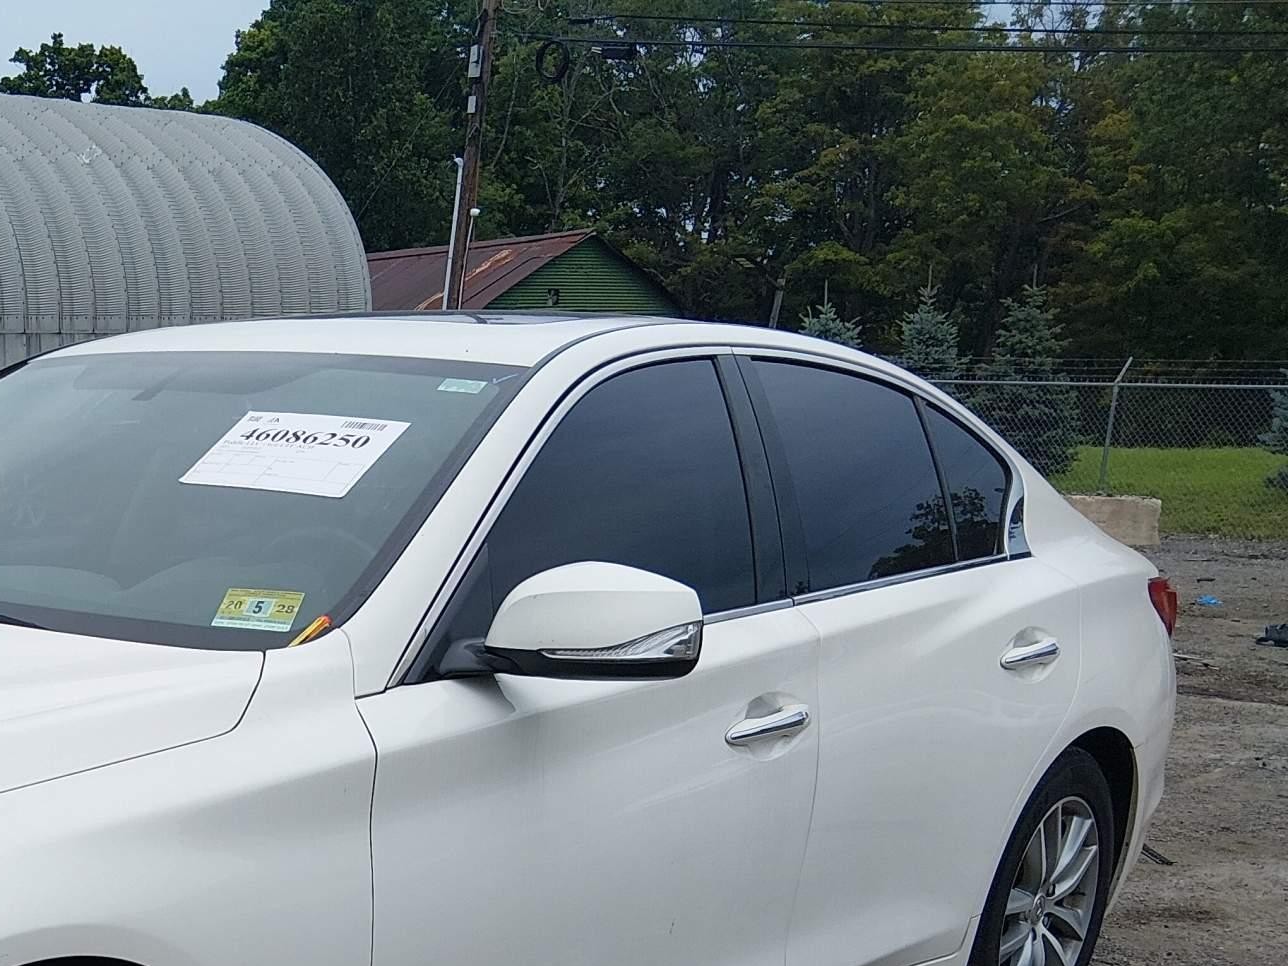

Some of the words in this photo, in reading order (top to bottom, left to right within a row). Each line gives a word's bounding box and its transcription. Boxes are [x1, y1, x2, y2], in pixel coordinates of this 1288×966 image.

[240, 427, 371, 449] 46086250
[225, 600, 243, 610] 20
[252, 600, 265, 614] 5
[275, 604, 295, 614] 28
